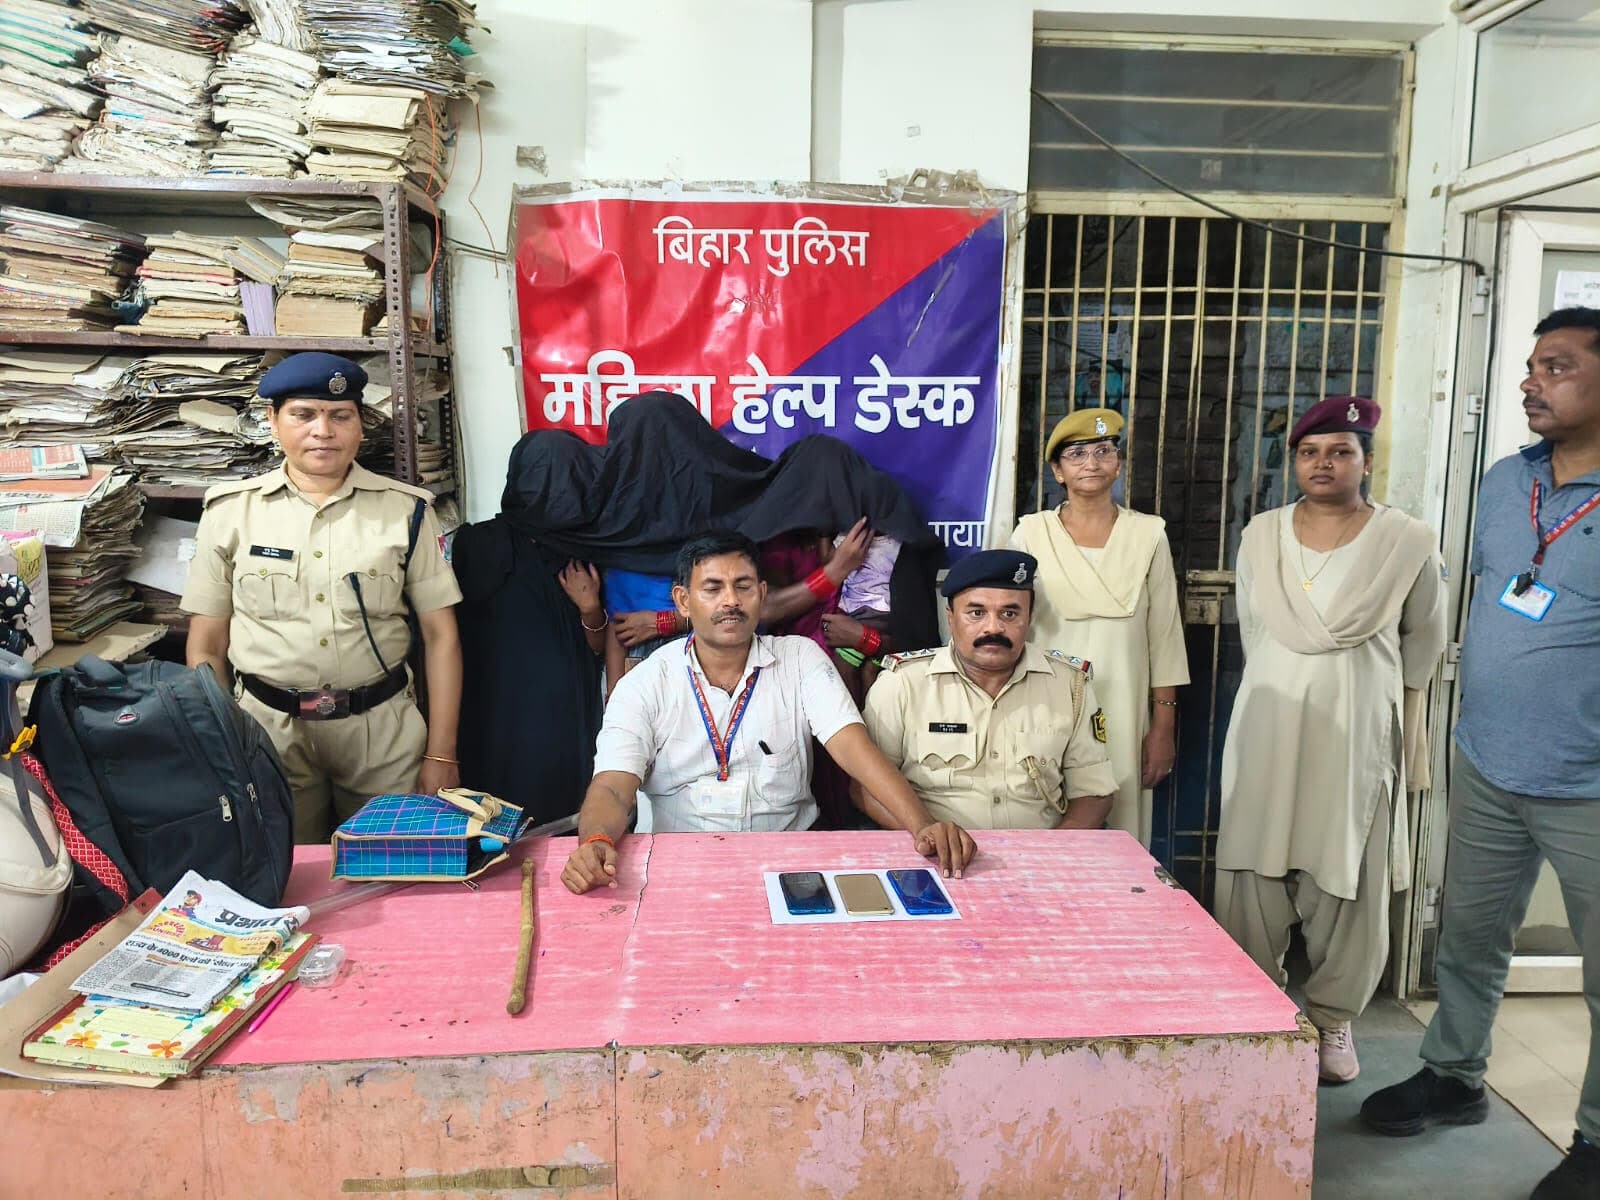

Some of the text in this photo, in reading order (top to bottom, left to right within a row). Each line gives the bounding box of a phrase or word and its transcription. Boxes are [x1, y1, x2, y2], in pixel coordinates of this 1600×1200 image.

[652, 215, 870, 276] बिहार पुलिस
[729, 353, 840, 434] हेल्प
[853, 353, 981, 434] डेस्क
